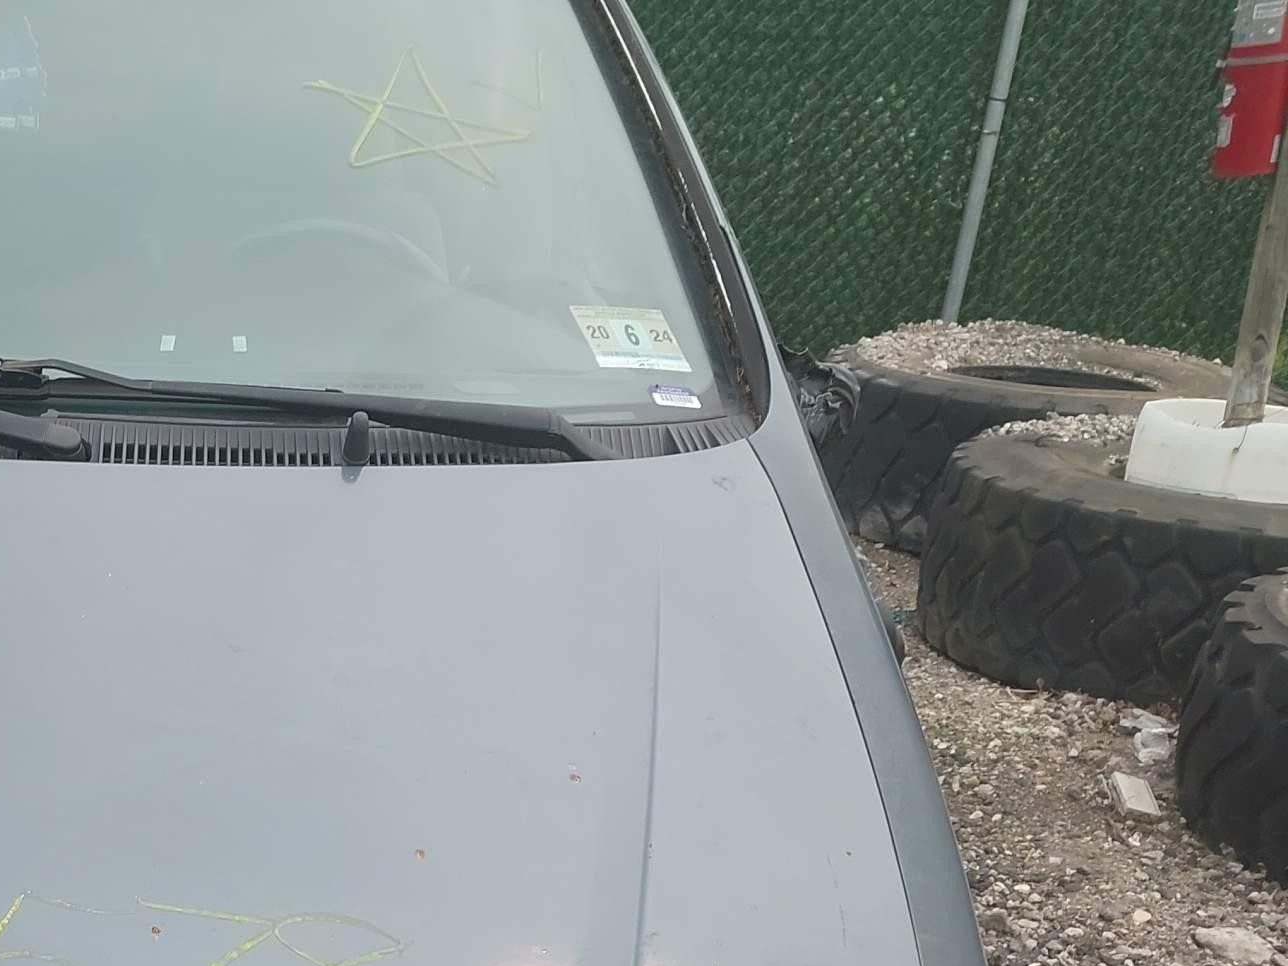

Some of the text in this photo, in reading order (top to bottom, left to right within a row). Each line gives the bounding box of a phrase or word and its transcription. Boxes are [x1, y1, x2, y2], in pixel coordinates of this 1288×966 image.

[586, 323, 673, 346] 20 6 24
